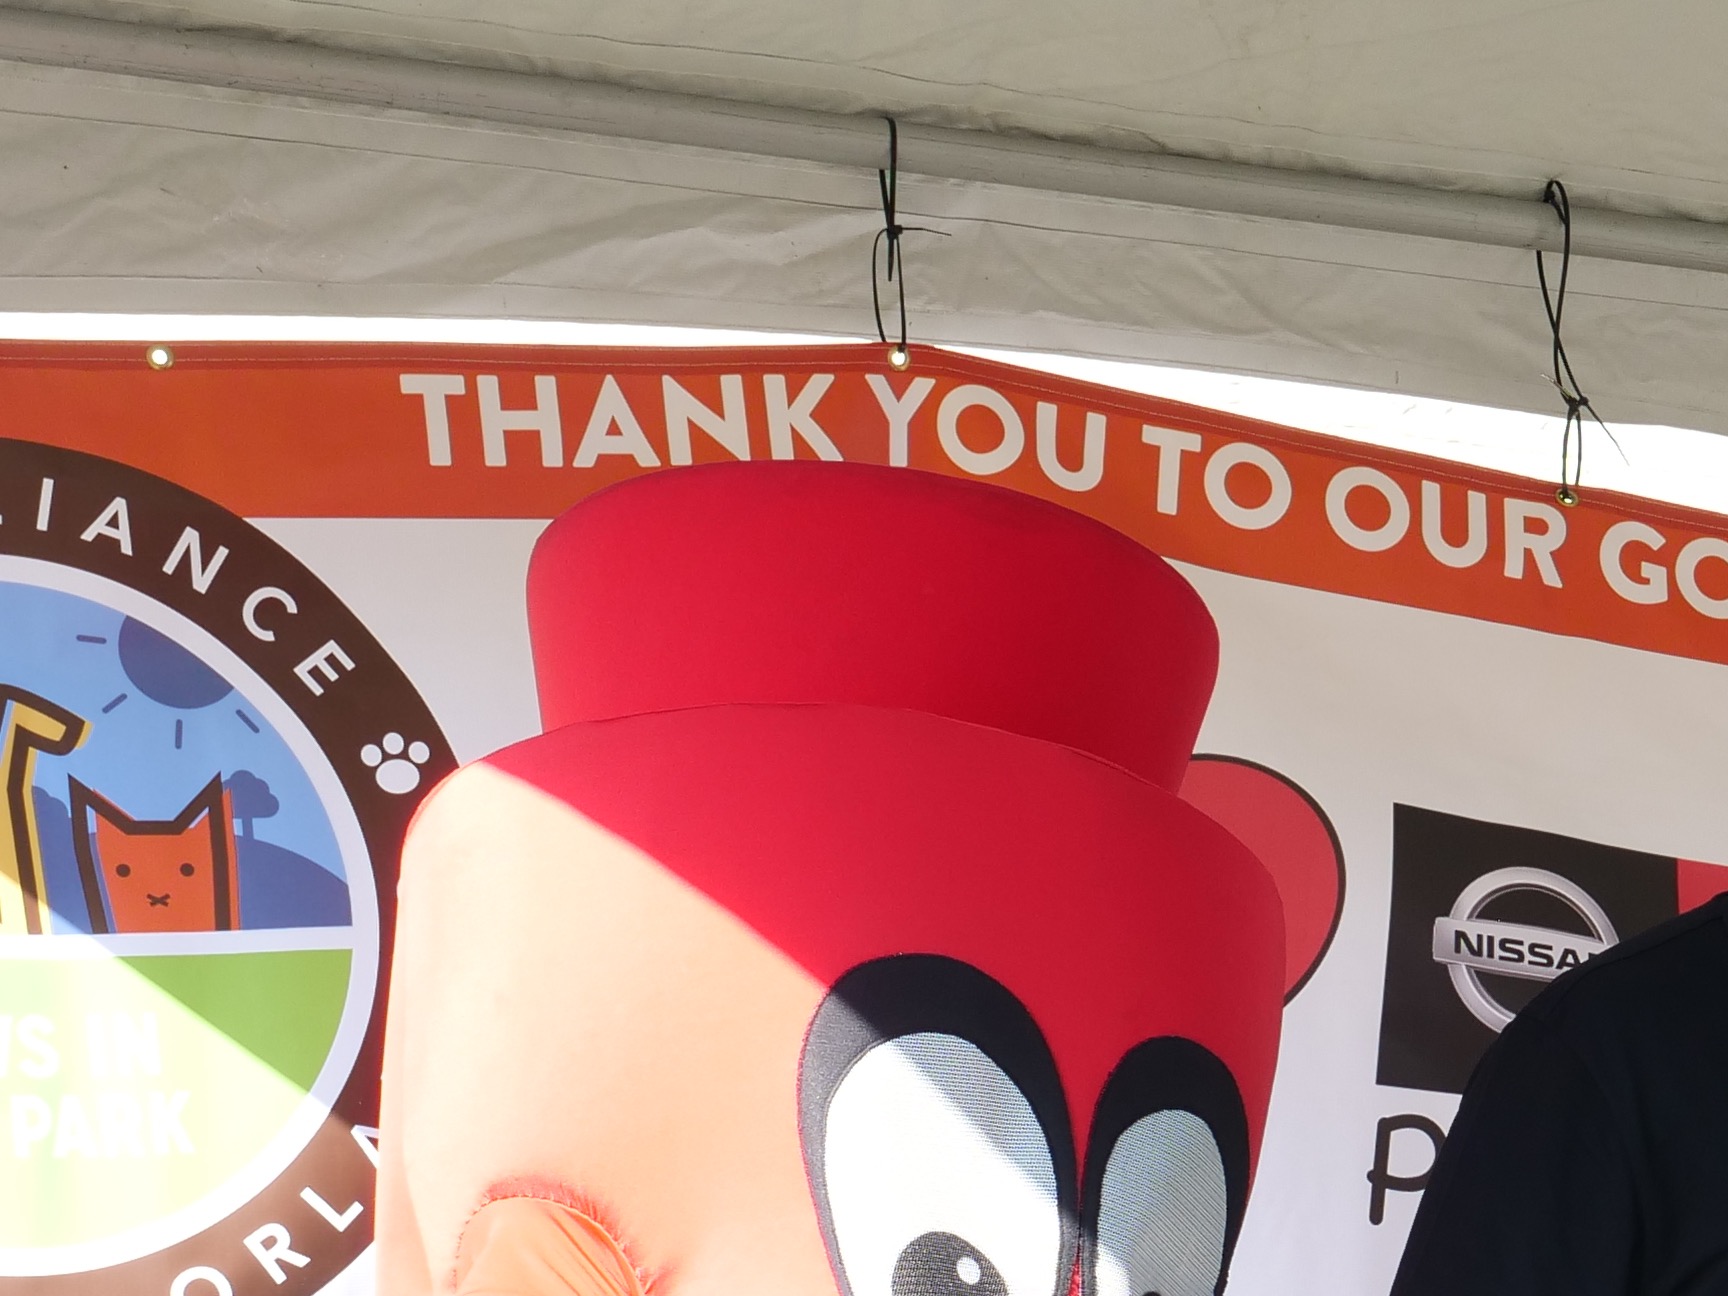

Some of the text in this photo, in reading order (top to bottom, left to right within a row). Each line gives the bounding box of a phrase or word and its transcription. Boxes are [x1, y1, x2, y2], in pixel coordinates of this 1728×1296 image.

[400, 373, 844, 467] THANK
[864, 374, 1107, 492] YOU
[1141, 425, 1292, 531] TO
[1325, 466, 1568, 589] OUR
[0, 477, 356, 697] IANCE
[1453, 929, 1600, 970] NISSA
[10, 1090, 195, 1159] PARK
